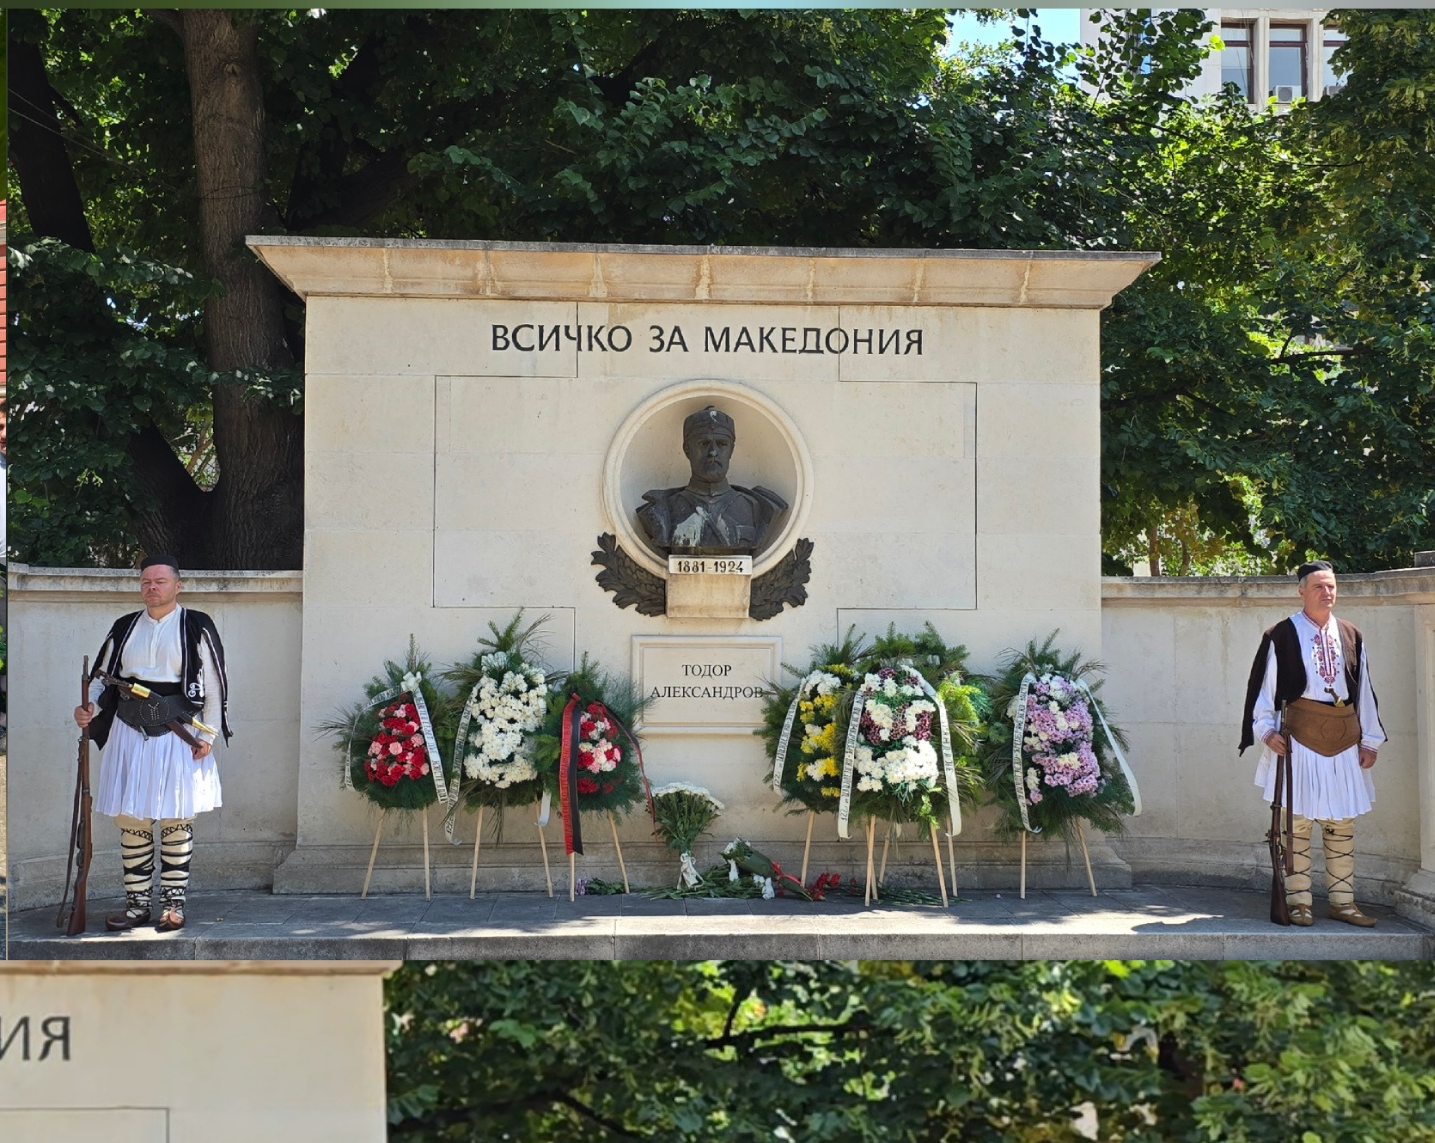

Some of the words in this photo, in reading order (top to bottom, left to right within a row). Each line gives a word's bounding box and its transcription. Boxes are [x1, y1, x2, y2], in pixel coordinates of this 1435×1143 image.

[491, 324, 633, 353] ВСИЧКО
[648, 325, 689, 353] ЗА
[703, 326, 924, 356] МАКЕДОНИЯ
[677, 560, 744, 573] 1881-1924
[682, 664, 732, 678] ТОДОР
[650, 686, 764, 700] АЛЕКСАНДРОВ
